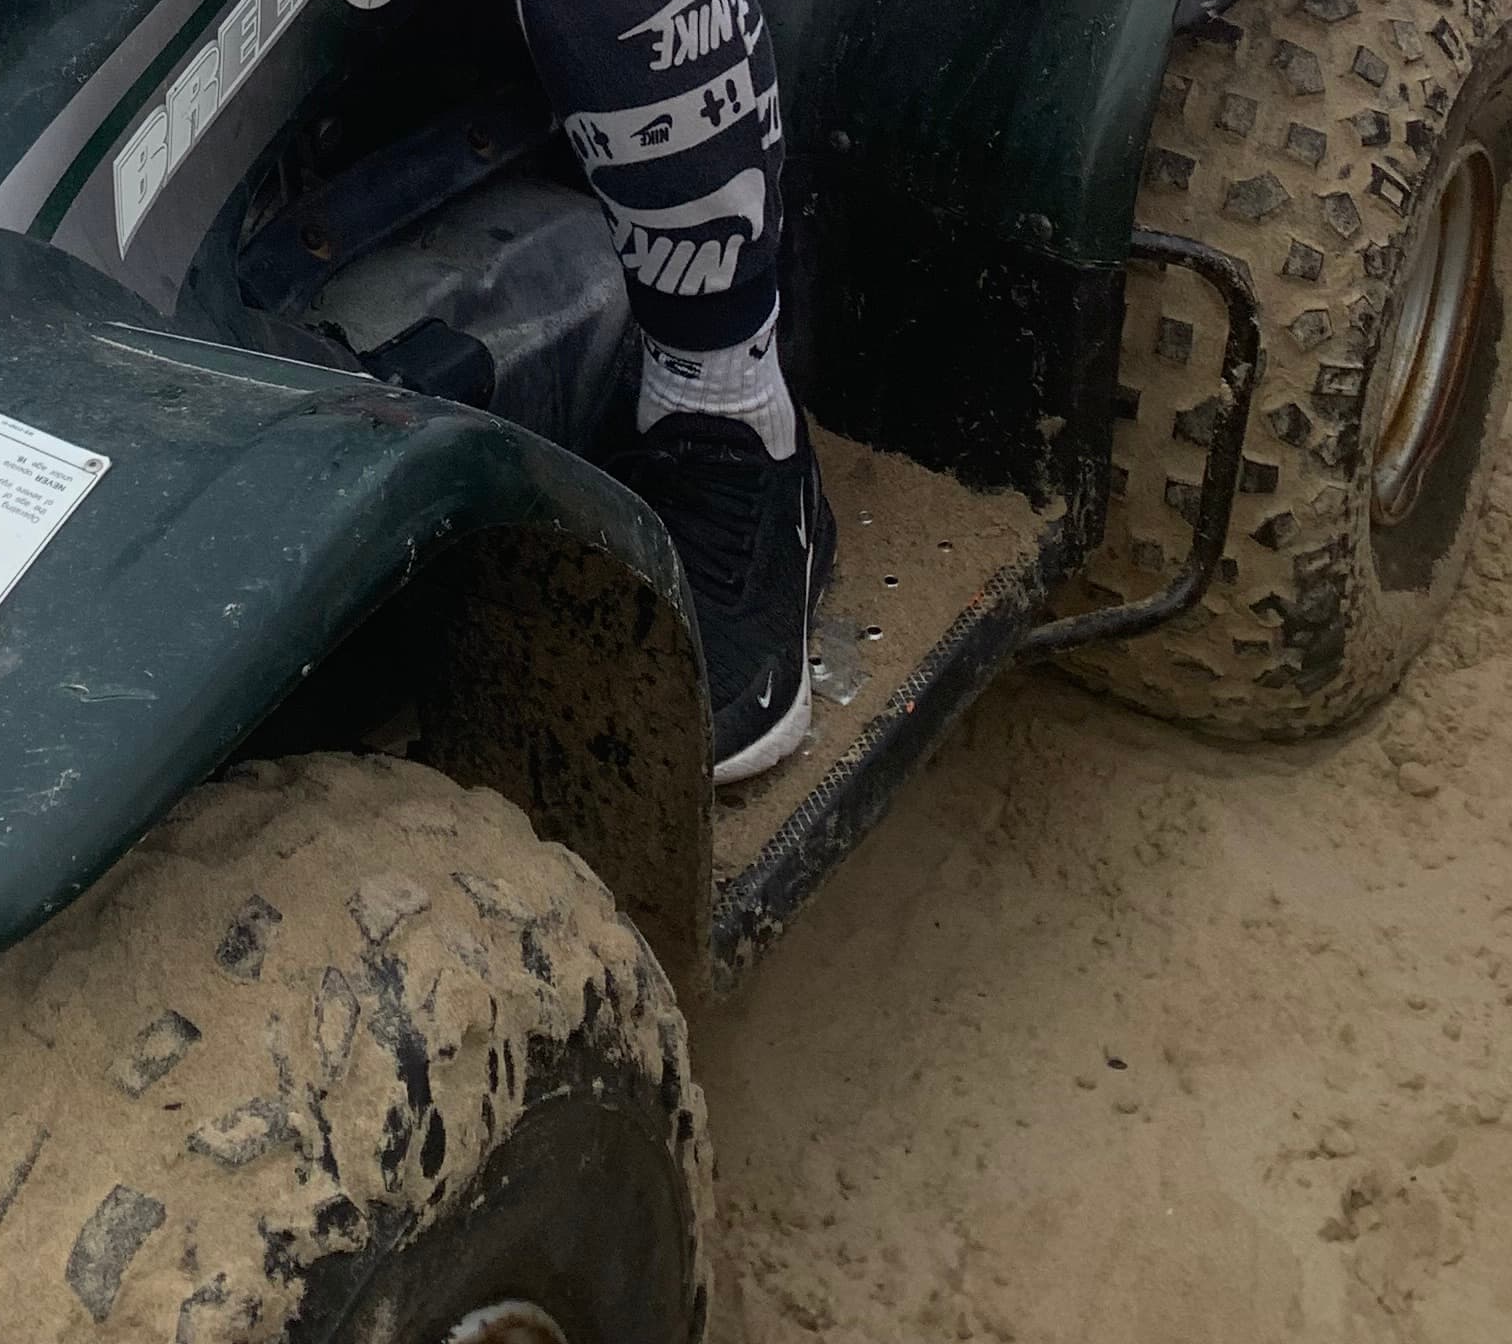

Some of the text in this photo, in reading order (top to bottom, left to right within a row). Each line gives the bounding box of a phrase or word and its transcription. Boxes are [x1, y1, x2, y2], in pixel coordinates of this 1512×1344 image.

[640, 127, 670, 147] NIKE
[622, 226, 745, 296] NIK
[33, 473, 67, 492] NEVER
